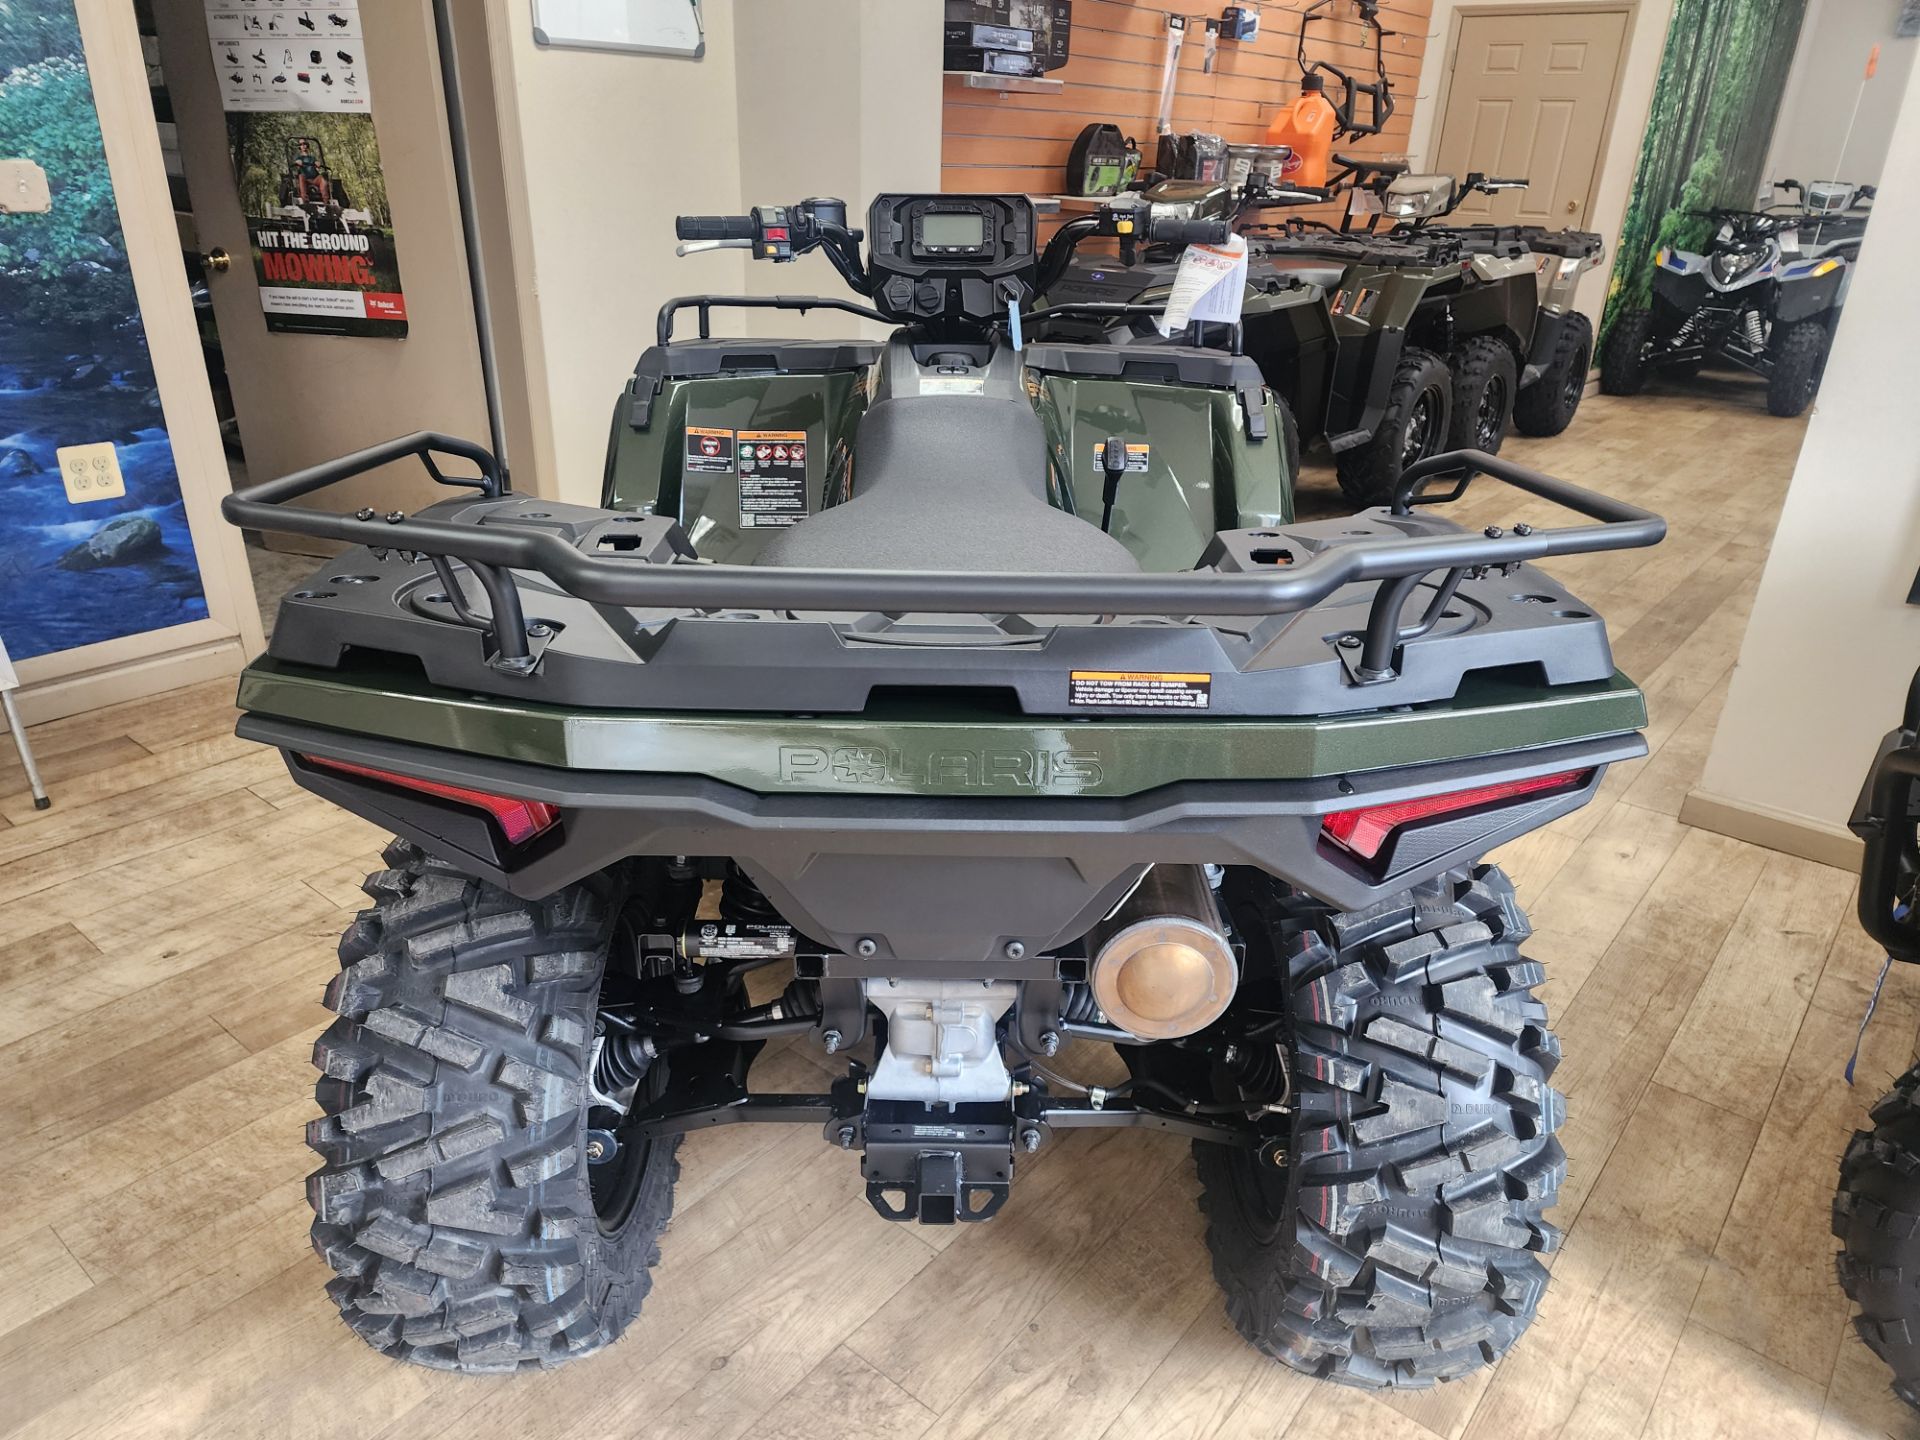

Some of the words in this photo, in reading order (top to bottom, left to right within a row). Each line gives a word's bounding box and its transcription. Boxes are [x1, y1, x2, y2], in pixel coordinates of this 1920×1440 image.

[256, 230, 279, 248] HIT
[282, 231, 309, 249] THE
[311, 232, 369, 252] GROUND
[262, 252, 376, 285] MOWING.
[778, 744, 1104, 788] POLARIS
